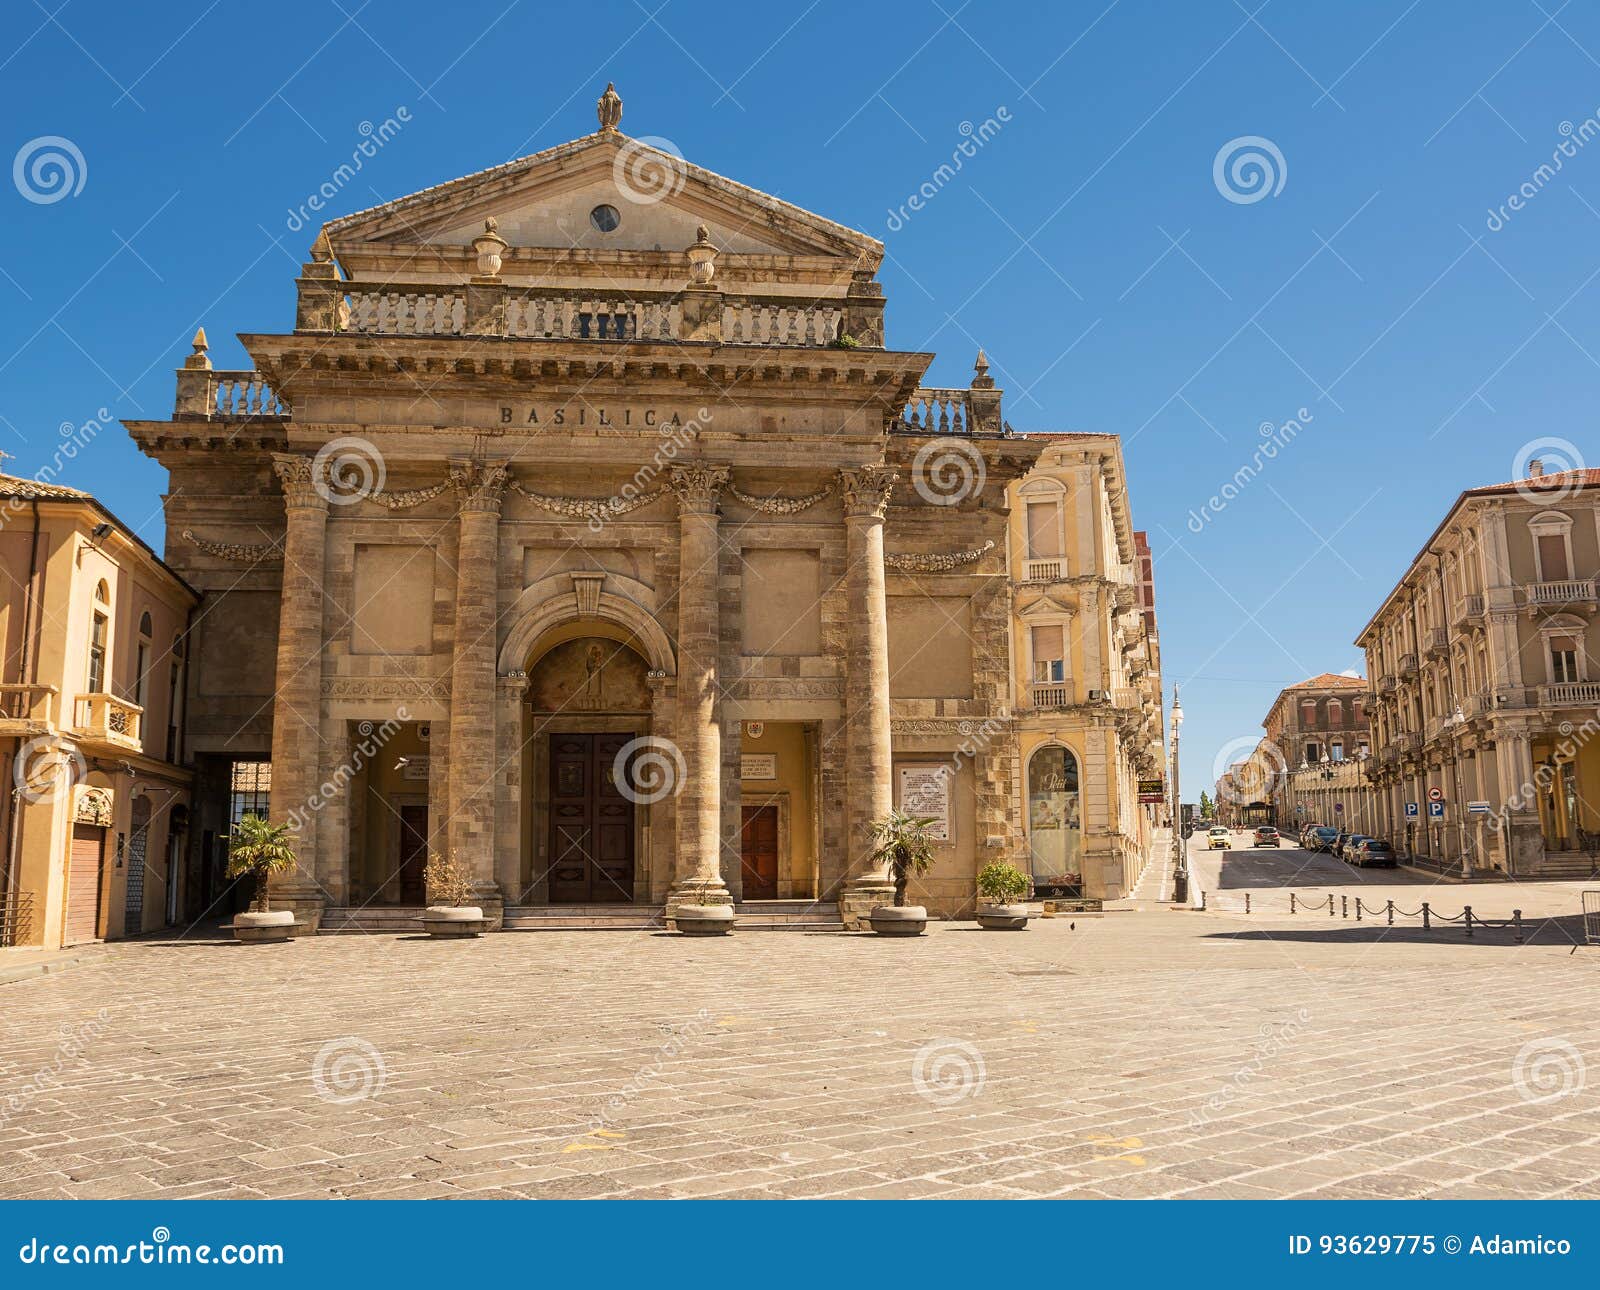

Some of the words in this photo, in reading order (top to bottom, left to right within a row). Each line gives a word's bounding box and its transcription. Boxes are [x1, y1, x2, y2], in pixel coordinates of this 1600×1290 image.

[500, 407, 682, 426] BASILICA
[1407, 804, 1417, 815] P
[1431, 803, 1441, 815] P
